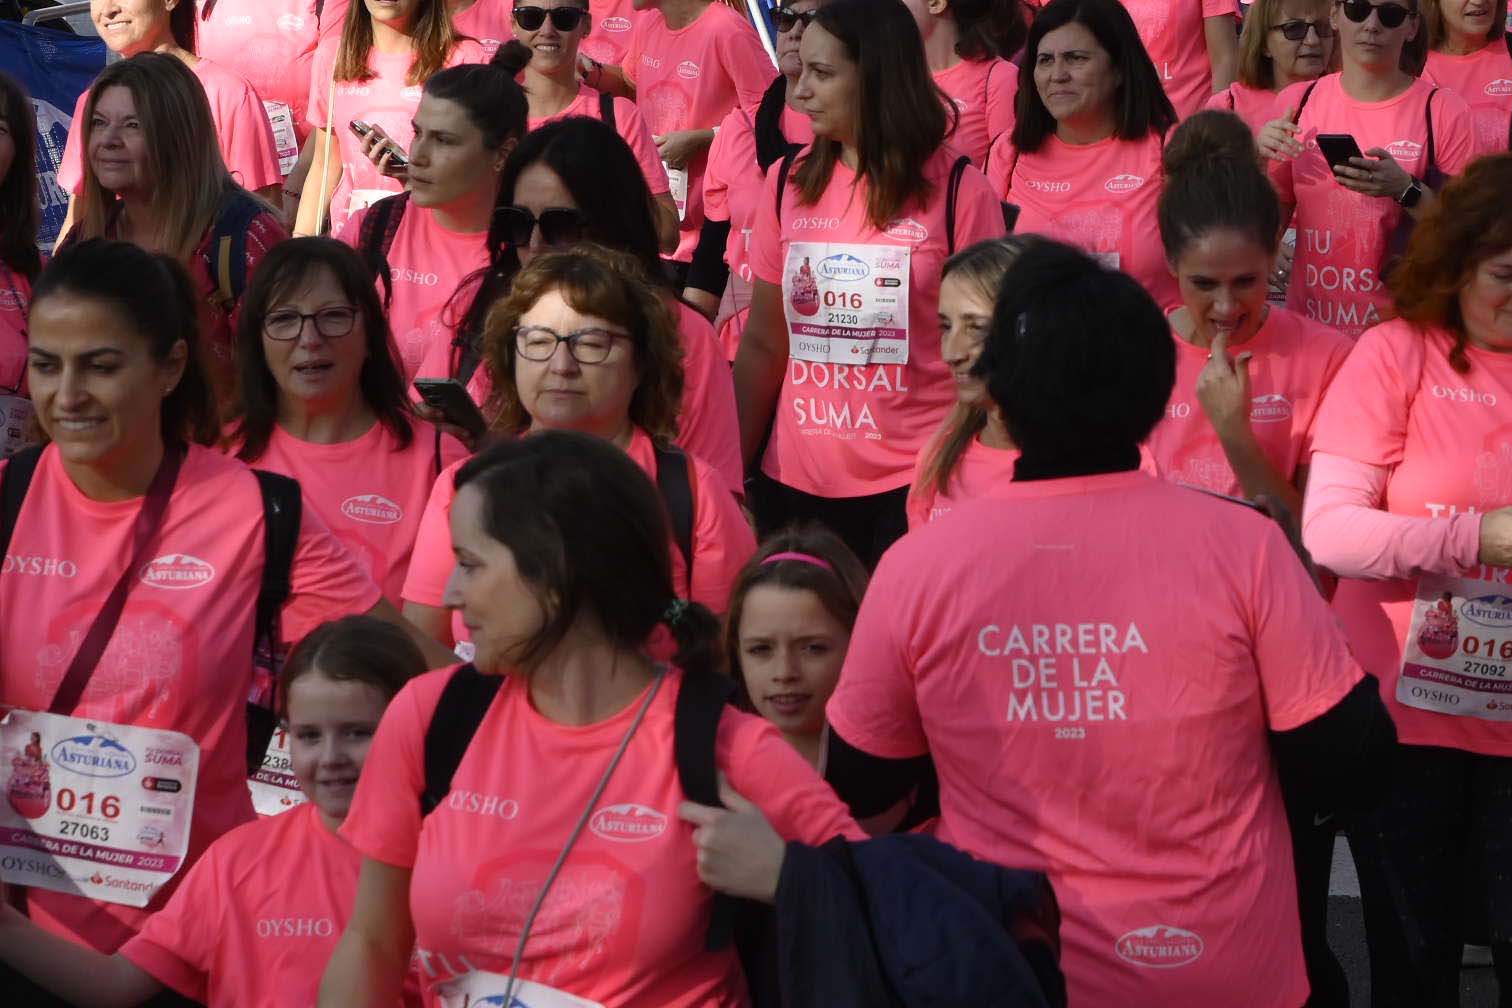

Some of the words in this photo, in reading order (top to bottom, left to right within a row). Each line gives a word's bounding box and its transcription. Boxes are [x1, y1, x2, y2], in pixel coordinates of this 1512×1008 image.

[793, 216, 840, 231] OYSHO
[1304, 229, 1331, 254] TU
[820, 262, 866, 277] ASTURIANA
[1306, 264, 1384, 292] DORS
[824, 291, 863, 309] 016
[828, 312, 858, 325] 21230
[1306, 300, 1380, 326] SUMA
[832, 327, 841, 336] DE
[842, 328, 851, 337] LA
[799, 342, 831, 354] OYSHO
[860, 346, 899, 356] Santander
[791, 359, 909, 393] DORSAL
[1432, 383, 1496, 407] OYSHO
[793, 397, 878, 429] SUMA
[346, 503, 399, 520] ASTURIANA
[145, 567, 213, 585] ASTURIANA
[977, 622, 1149, 656] CARRERA
[1012, 658, 1058, 688] DE
[1072, 657, 1118, 687] LA
[1419, 669, 1463, 684] CARRERA
[1466, 679, 1476, 688] DE
[1479, 680, 1491, 689] LA
[1464, 661, 1506, 677] 27092
[1007, 690, 1127, 721] MUJER
[1412, 686, 1460, 706] OYSHO
[1055, 728, 1086, 739] 2023
[57, 747, 129, 771] ASTURIANA
[144, 752, 182, 766] SUMA
[56, 788, 121, 820] 016
[59, 820, 110, 842] 27063
[62, 845, 77, 855] DE
[80, 846, 94, 858] LA
[95, 849, 134, 865] MUJER
[258, 918, 334, 938] OYSHO
[1121, 940, 1199, 957] ASTURIANA
